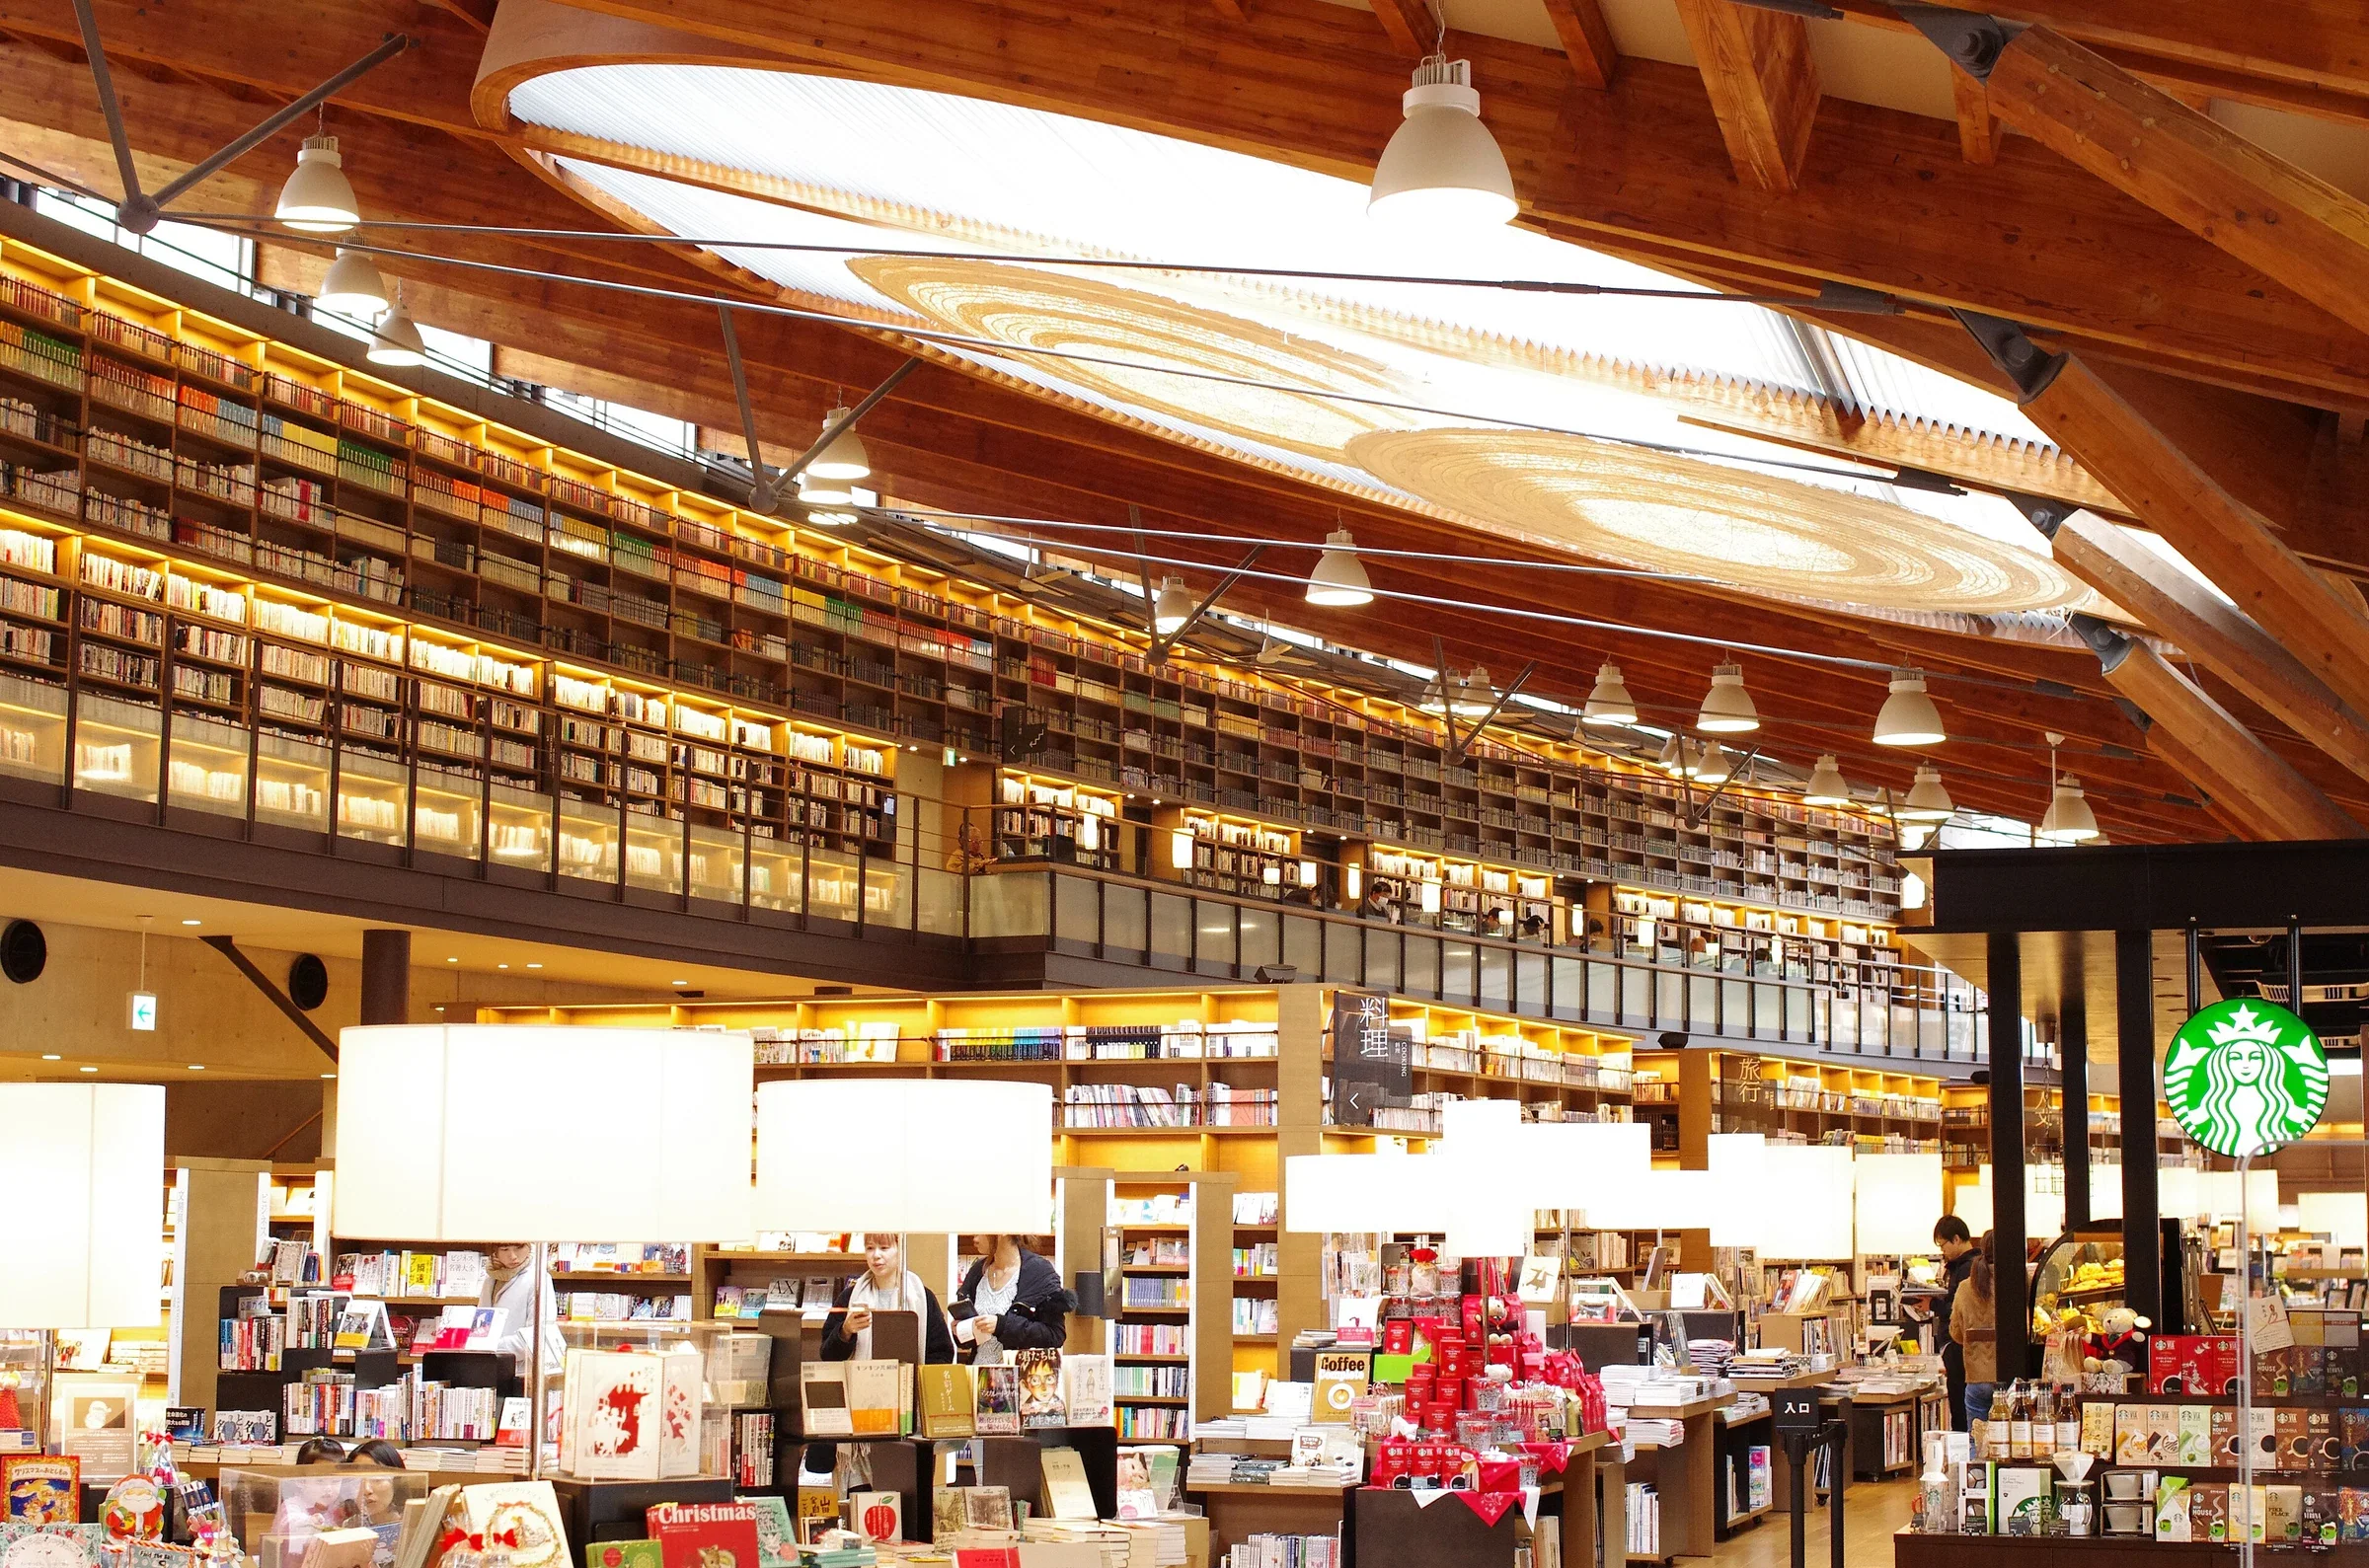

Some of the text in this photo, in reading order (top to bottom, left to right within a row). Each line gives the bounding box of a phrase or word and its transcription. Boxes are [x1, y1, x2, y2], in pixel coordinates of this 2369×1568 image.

[1359, 997, 1389, 1058] 料理
[1738, 1058, 1761, 1103] 旅行
[417, 1263, 425, 1284] 瞬速
[449, 1263, 476, 1273] 名著大全
[770, 1280, 797, 1295] AX
[1023, 1349, 1057, 1363] 君たちは
[1321, 1357, 1365, 1372] Coffee
[1784, 1401, 1810, 1414] 入口
[1023, 1415, 1066, 1428] どう生きるか
[14, 1467, 68, 1476] クリスマスのおとしもの
[820, 1495, 831, 1514] 山田
[657, 1504, 757, 1525] Christmas
